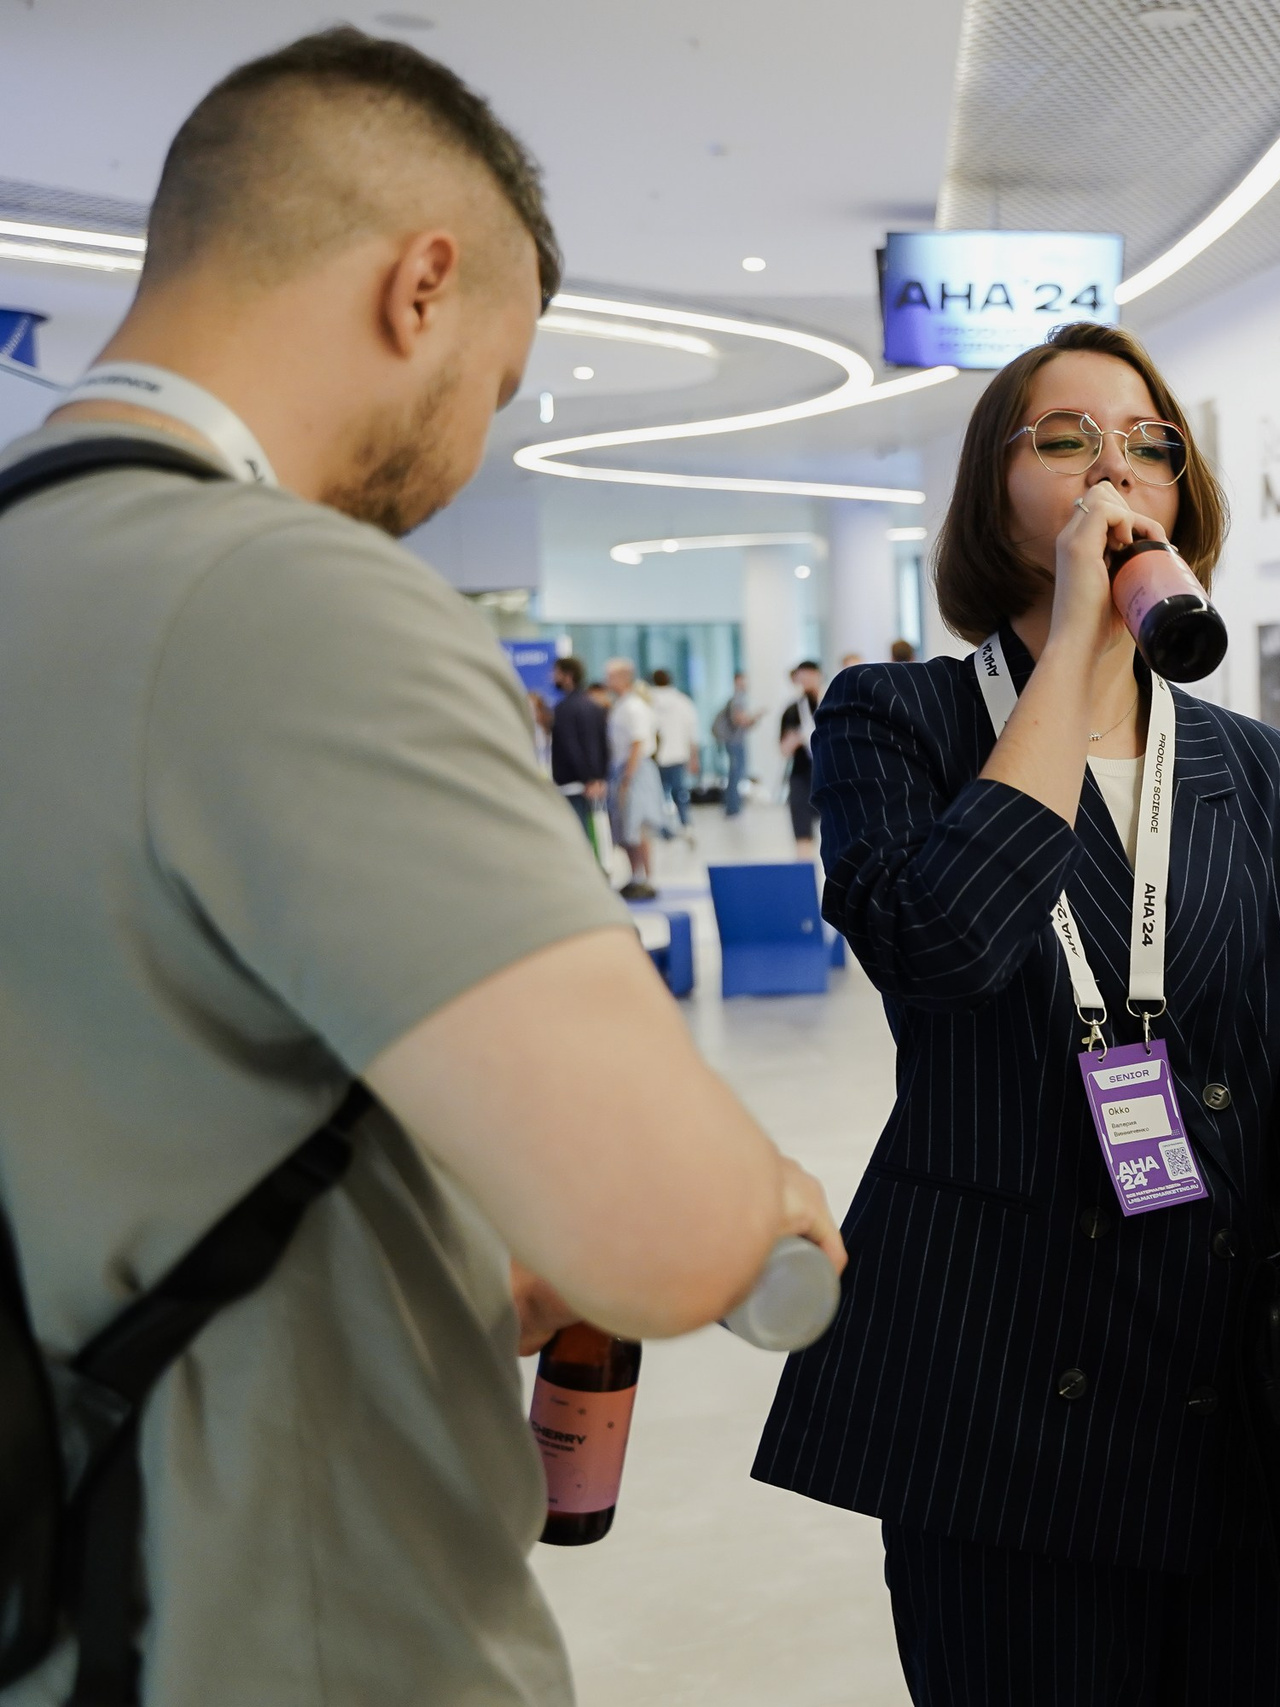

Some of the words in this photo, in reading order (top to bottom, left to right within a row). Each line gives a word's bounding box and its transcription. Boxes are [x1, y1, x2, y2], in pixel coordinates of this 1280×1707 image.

[897, 280, 1014, 312] AHA
[1154, 732, 1167, 785] PRODUCT
[1150, 786, 1162, 834] SCIENCE
[1109, 1069, 1150, 1083] SENIOR
[1108, 1106, 1130, 1116] Okko
[1119, 1155, 1160, 1176] AHA
